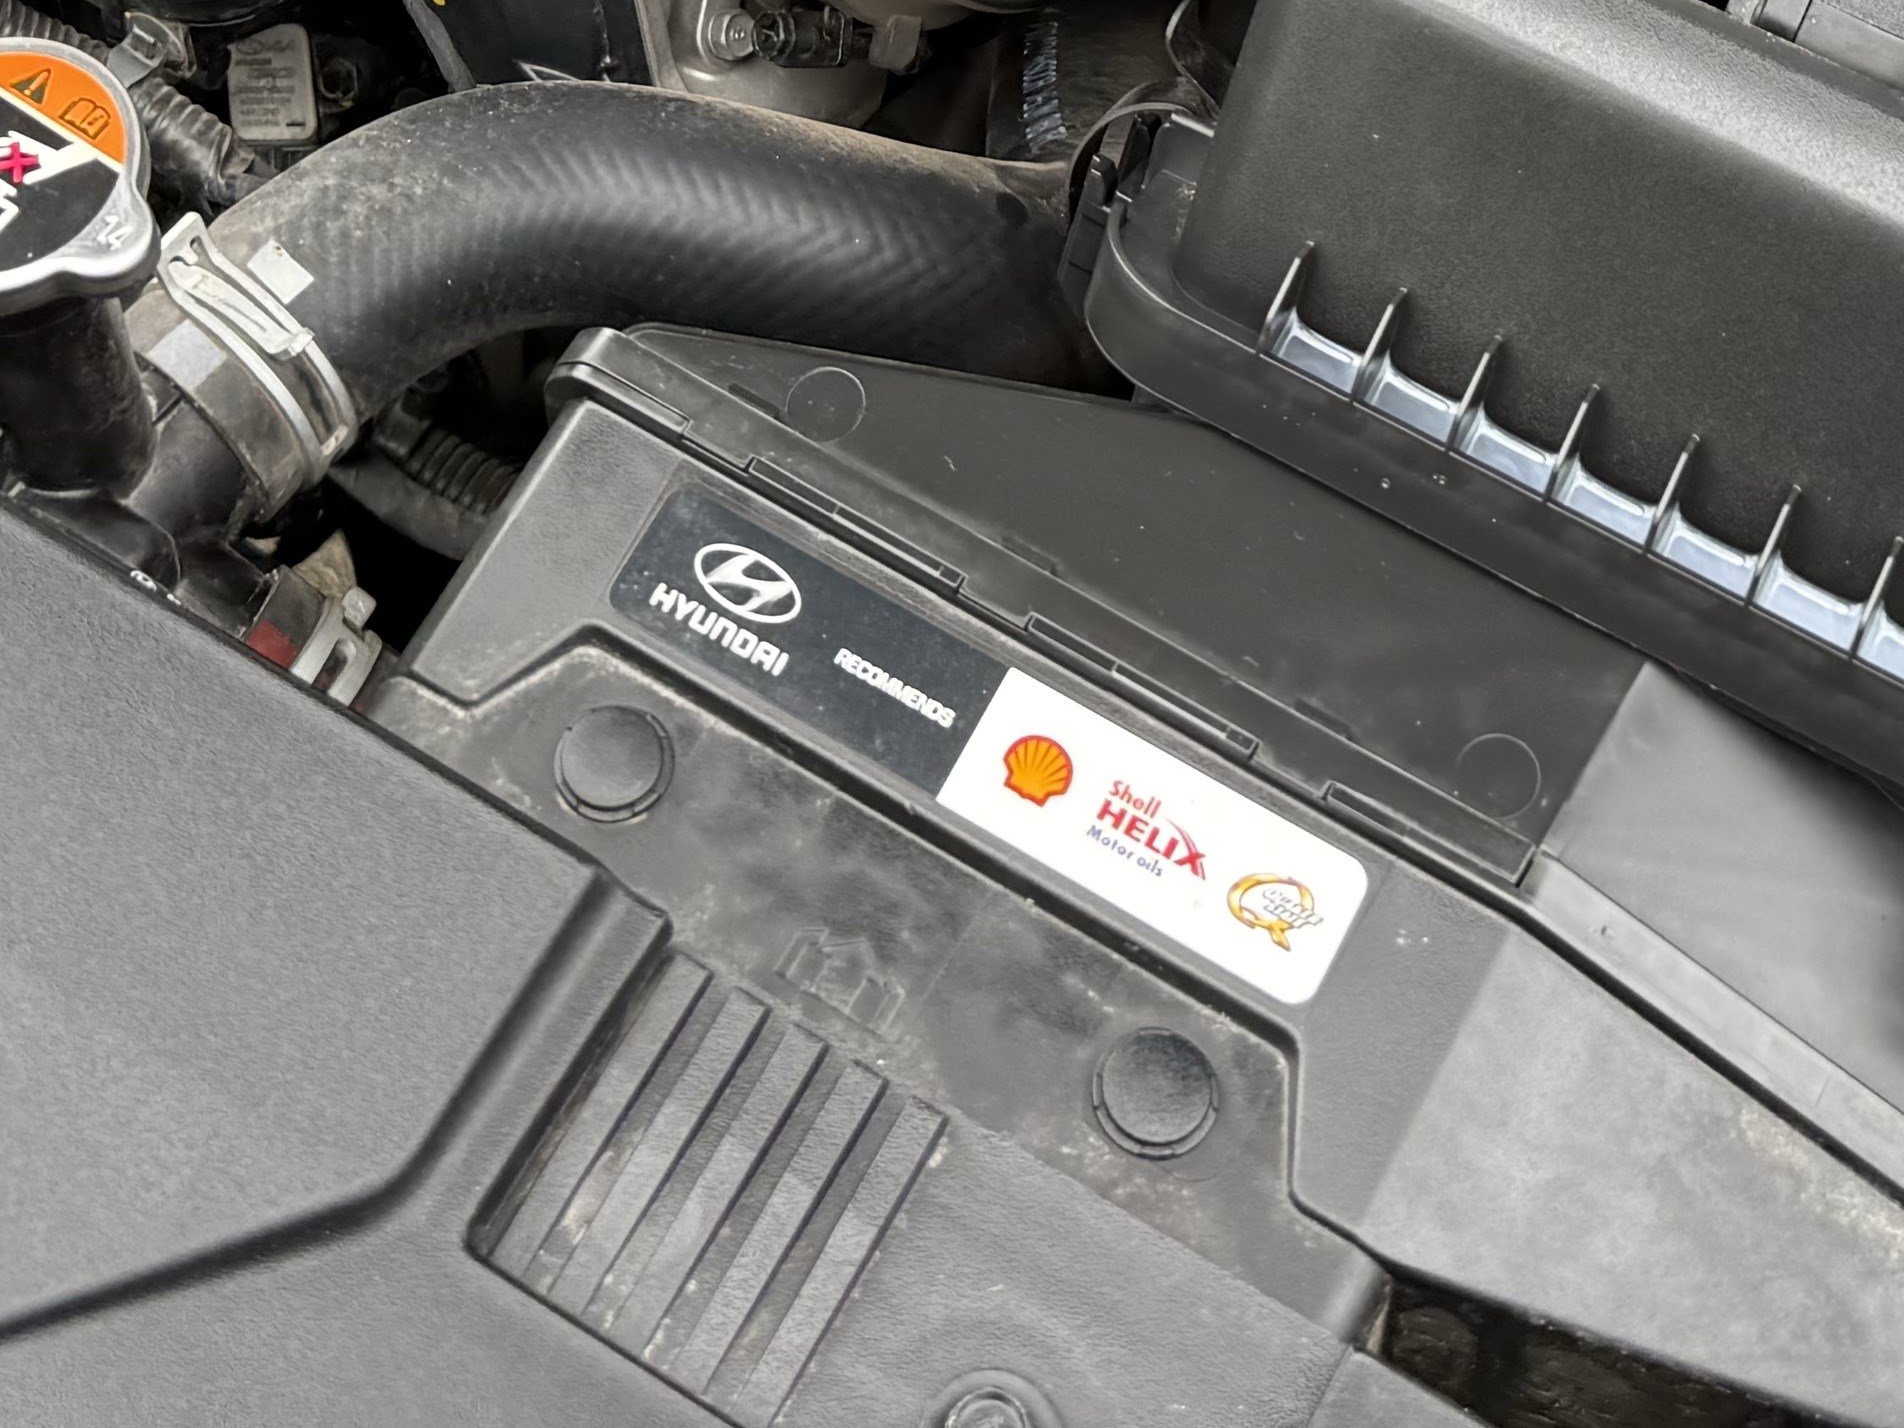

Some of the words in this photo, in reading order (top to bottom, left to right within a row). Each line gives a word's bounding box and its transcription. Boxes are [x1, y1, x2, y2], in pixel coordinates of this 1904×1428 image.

[95, 213, 134, 251] 14
[648, 581, 789, 678] HYUNDAI
[832, 646, 956, 729] RECOMMENDS
[1108, 779, 1162, 819] Shell
[1086, 824, 1134, 860] Motor
[1136, 856, 1163, 877] oils
[1096, 798, 1206, 882] HELIX
